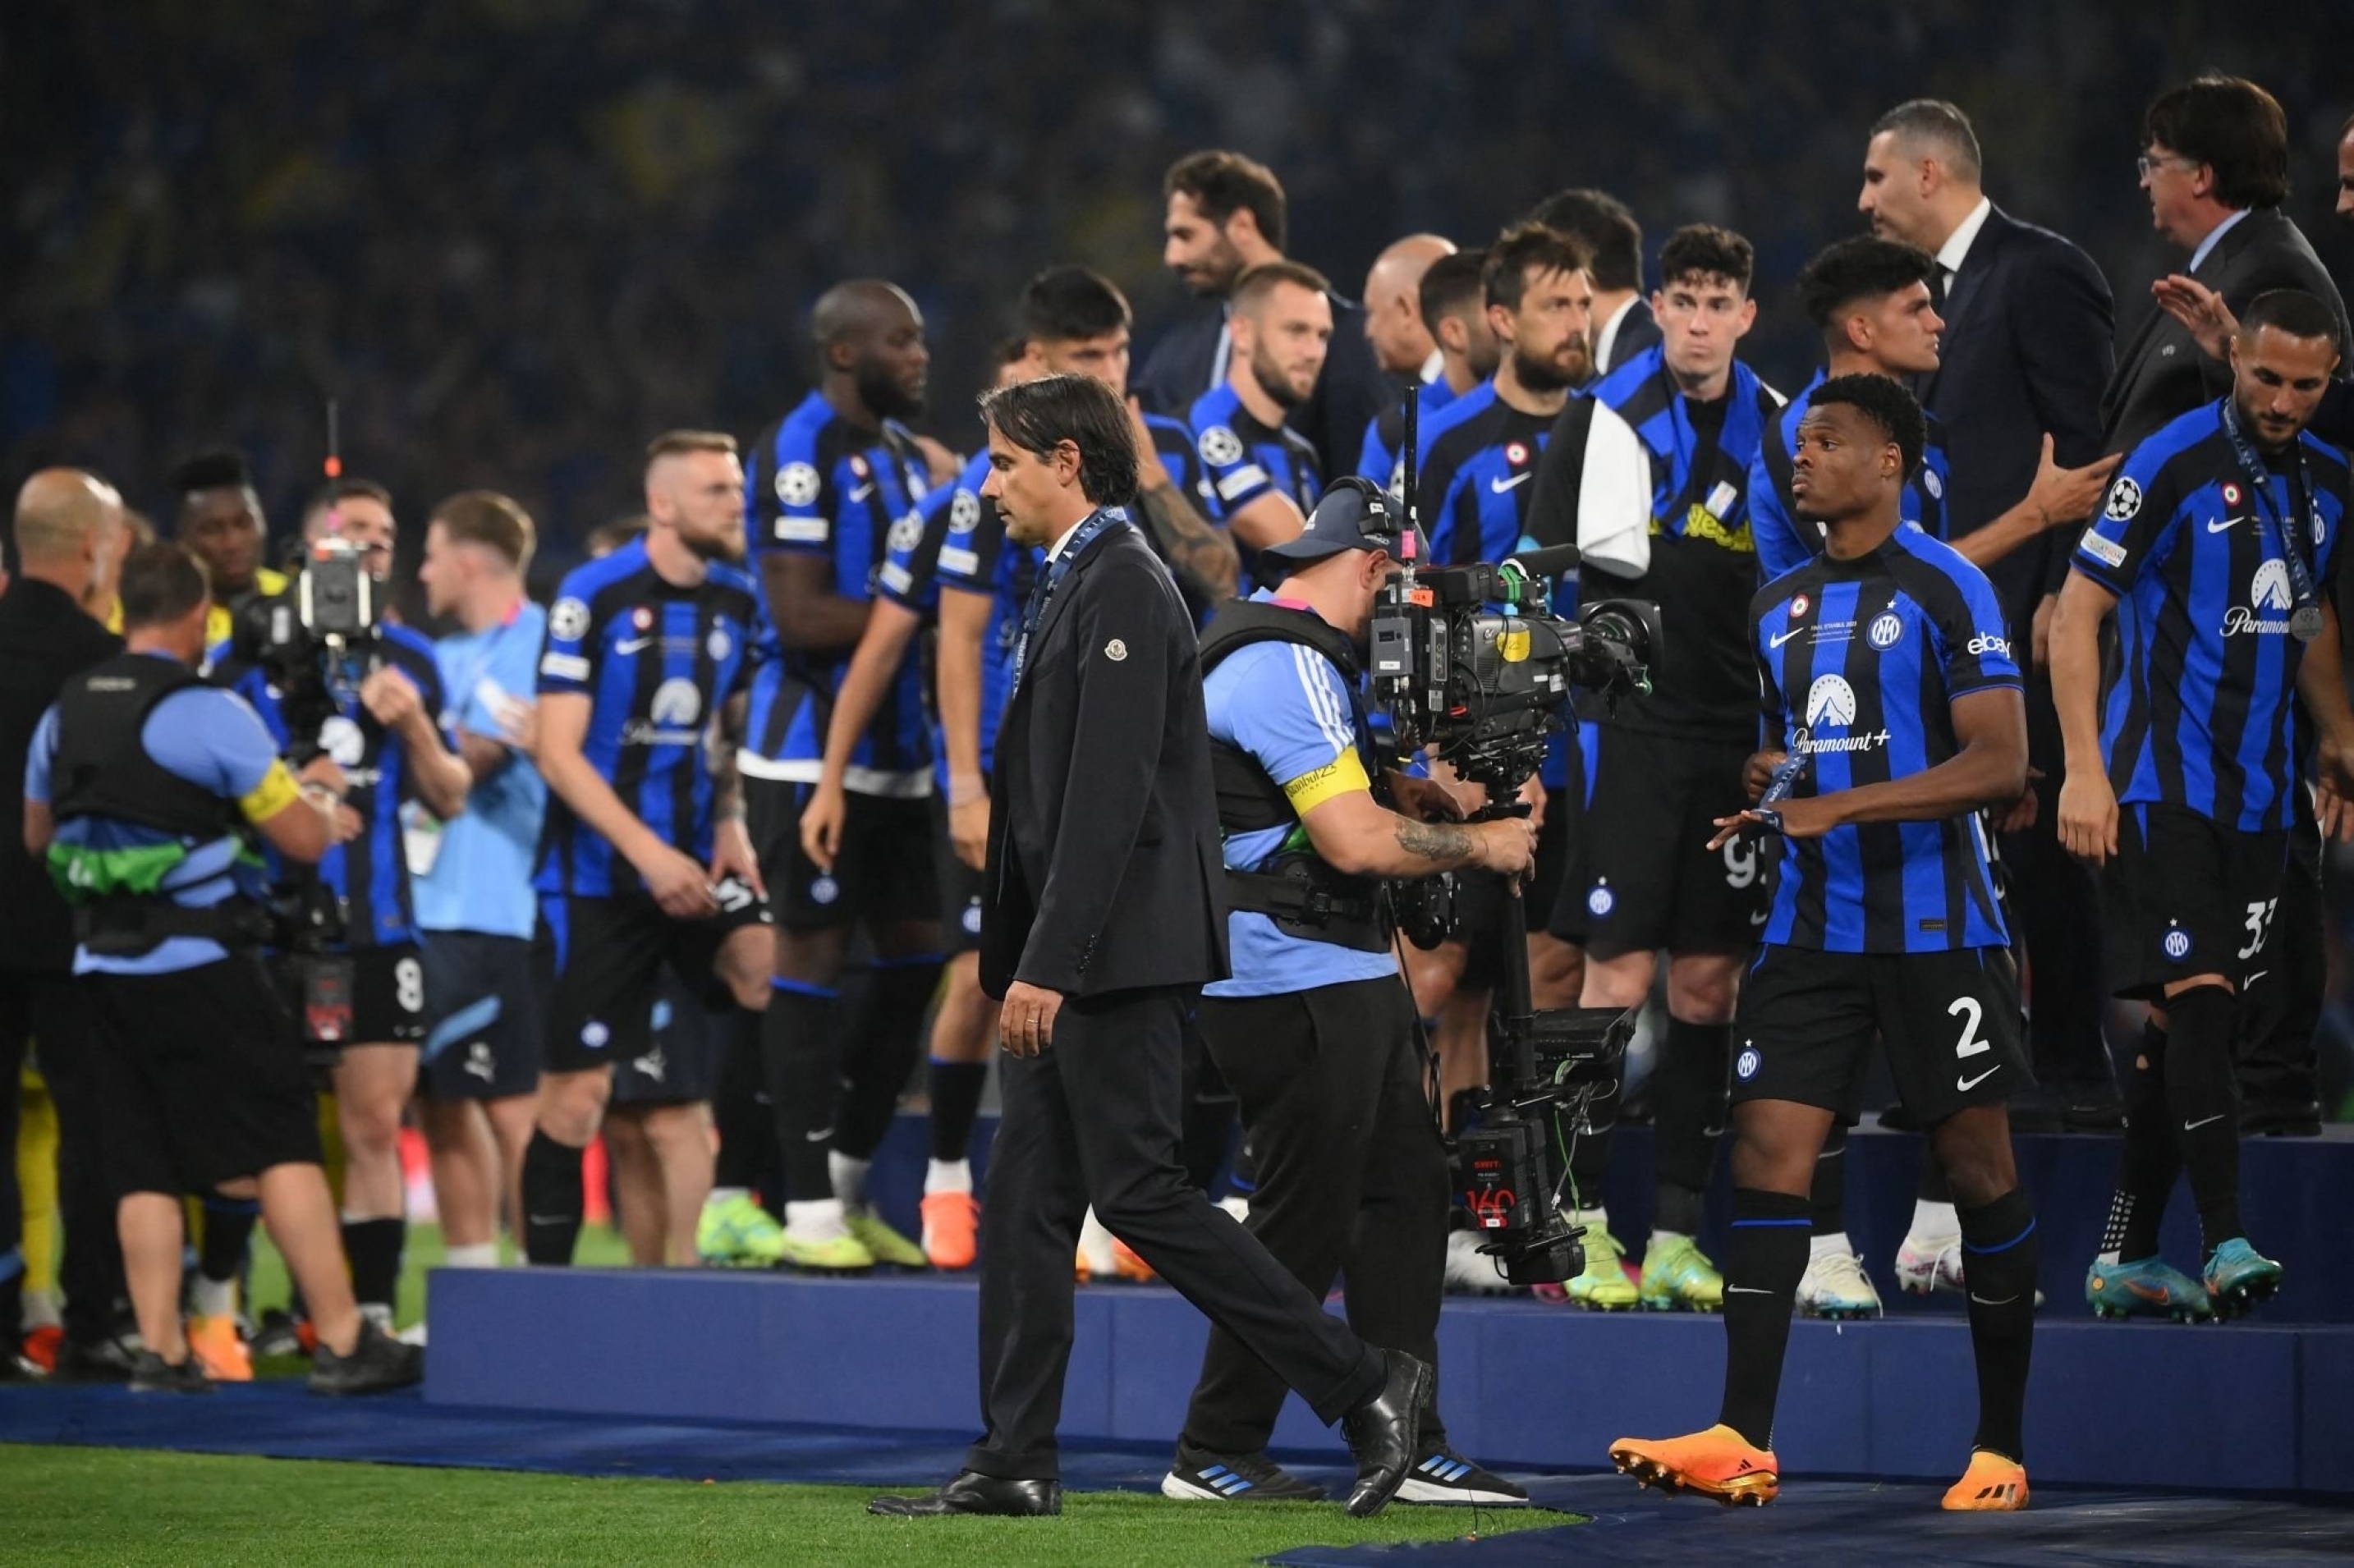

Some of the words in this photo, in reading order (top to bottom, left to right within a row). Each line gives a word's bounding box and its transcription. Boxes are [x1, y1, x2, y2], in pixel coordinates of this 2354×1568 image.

[1967, 630, 2011, 659] ebay
[1793, 727, 1891, 754] Paramount+
[395, 957, 424, 1013] 8
[1948, 996, 1990, 1059] 2
[1466, 1189, 1517, 1229] 160
